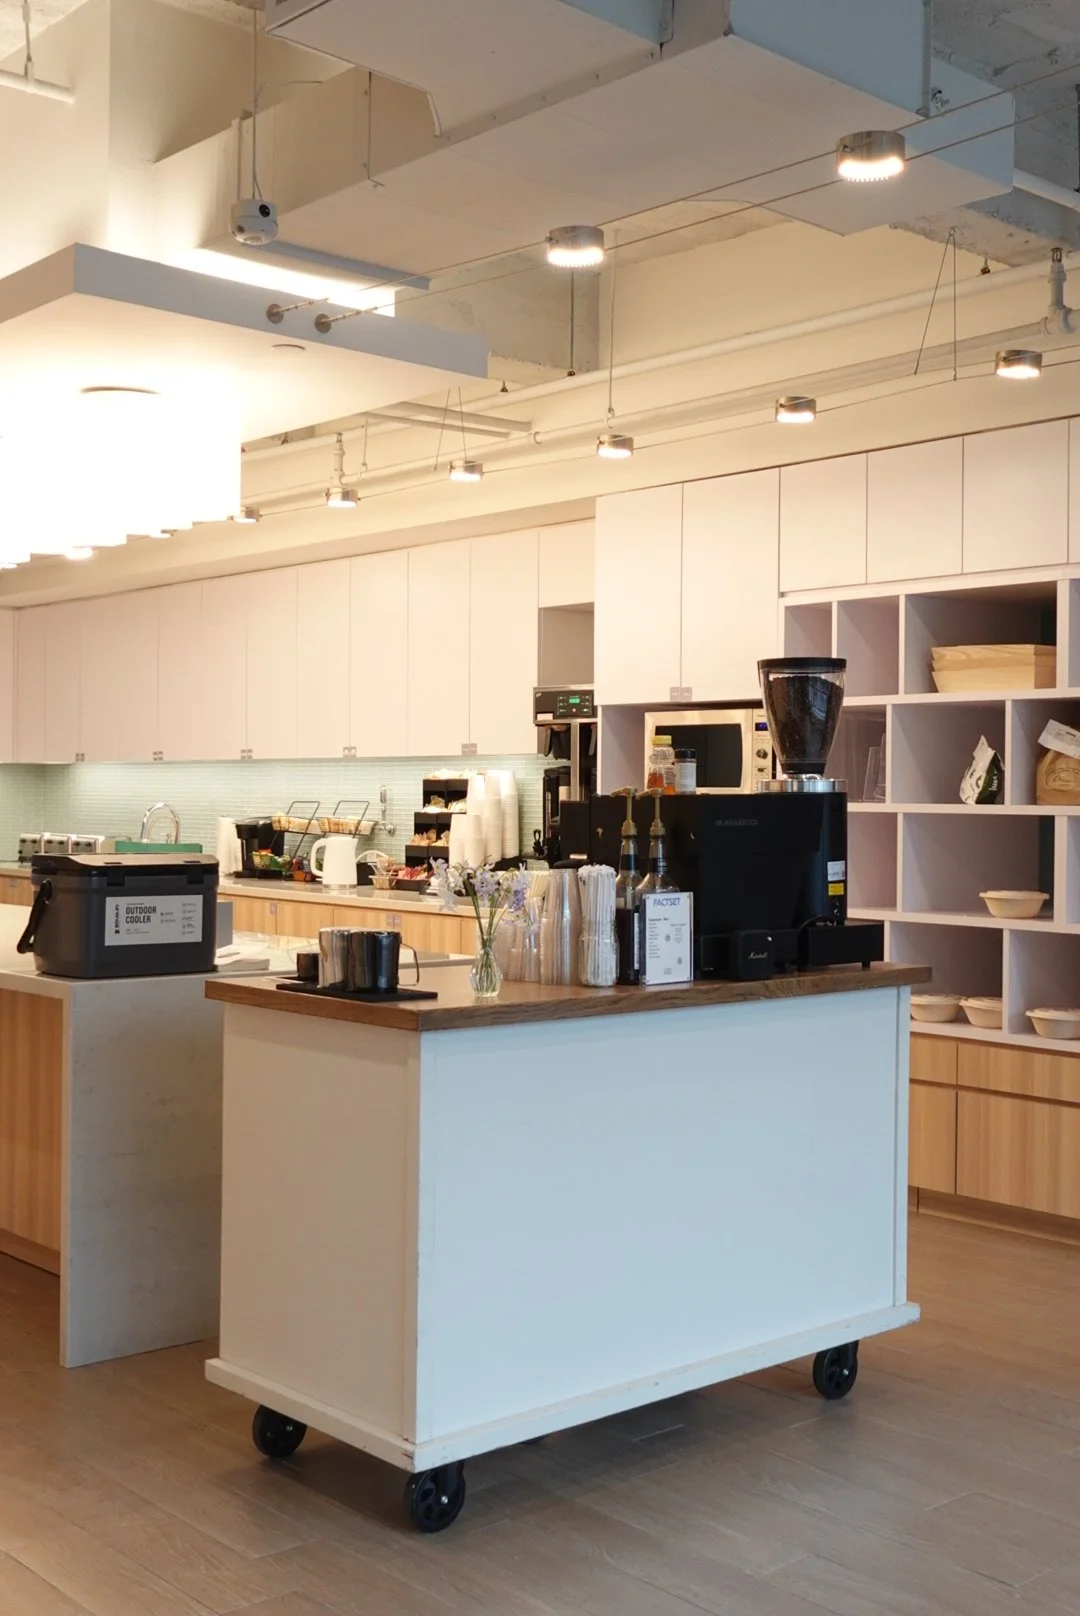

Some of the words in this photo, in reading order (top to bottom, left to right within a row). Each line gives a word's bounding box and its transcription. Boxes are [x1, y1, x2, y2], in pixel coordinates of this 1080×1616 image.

[653, 897, 681, 906] FACTSET
[125, 906, 157, 915] OUTDOOR
[125, 915, 151, 924] COOLER
